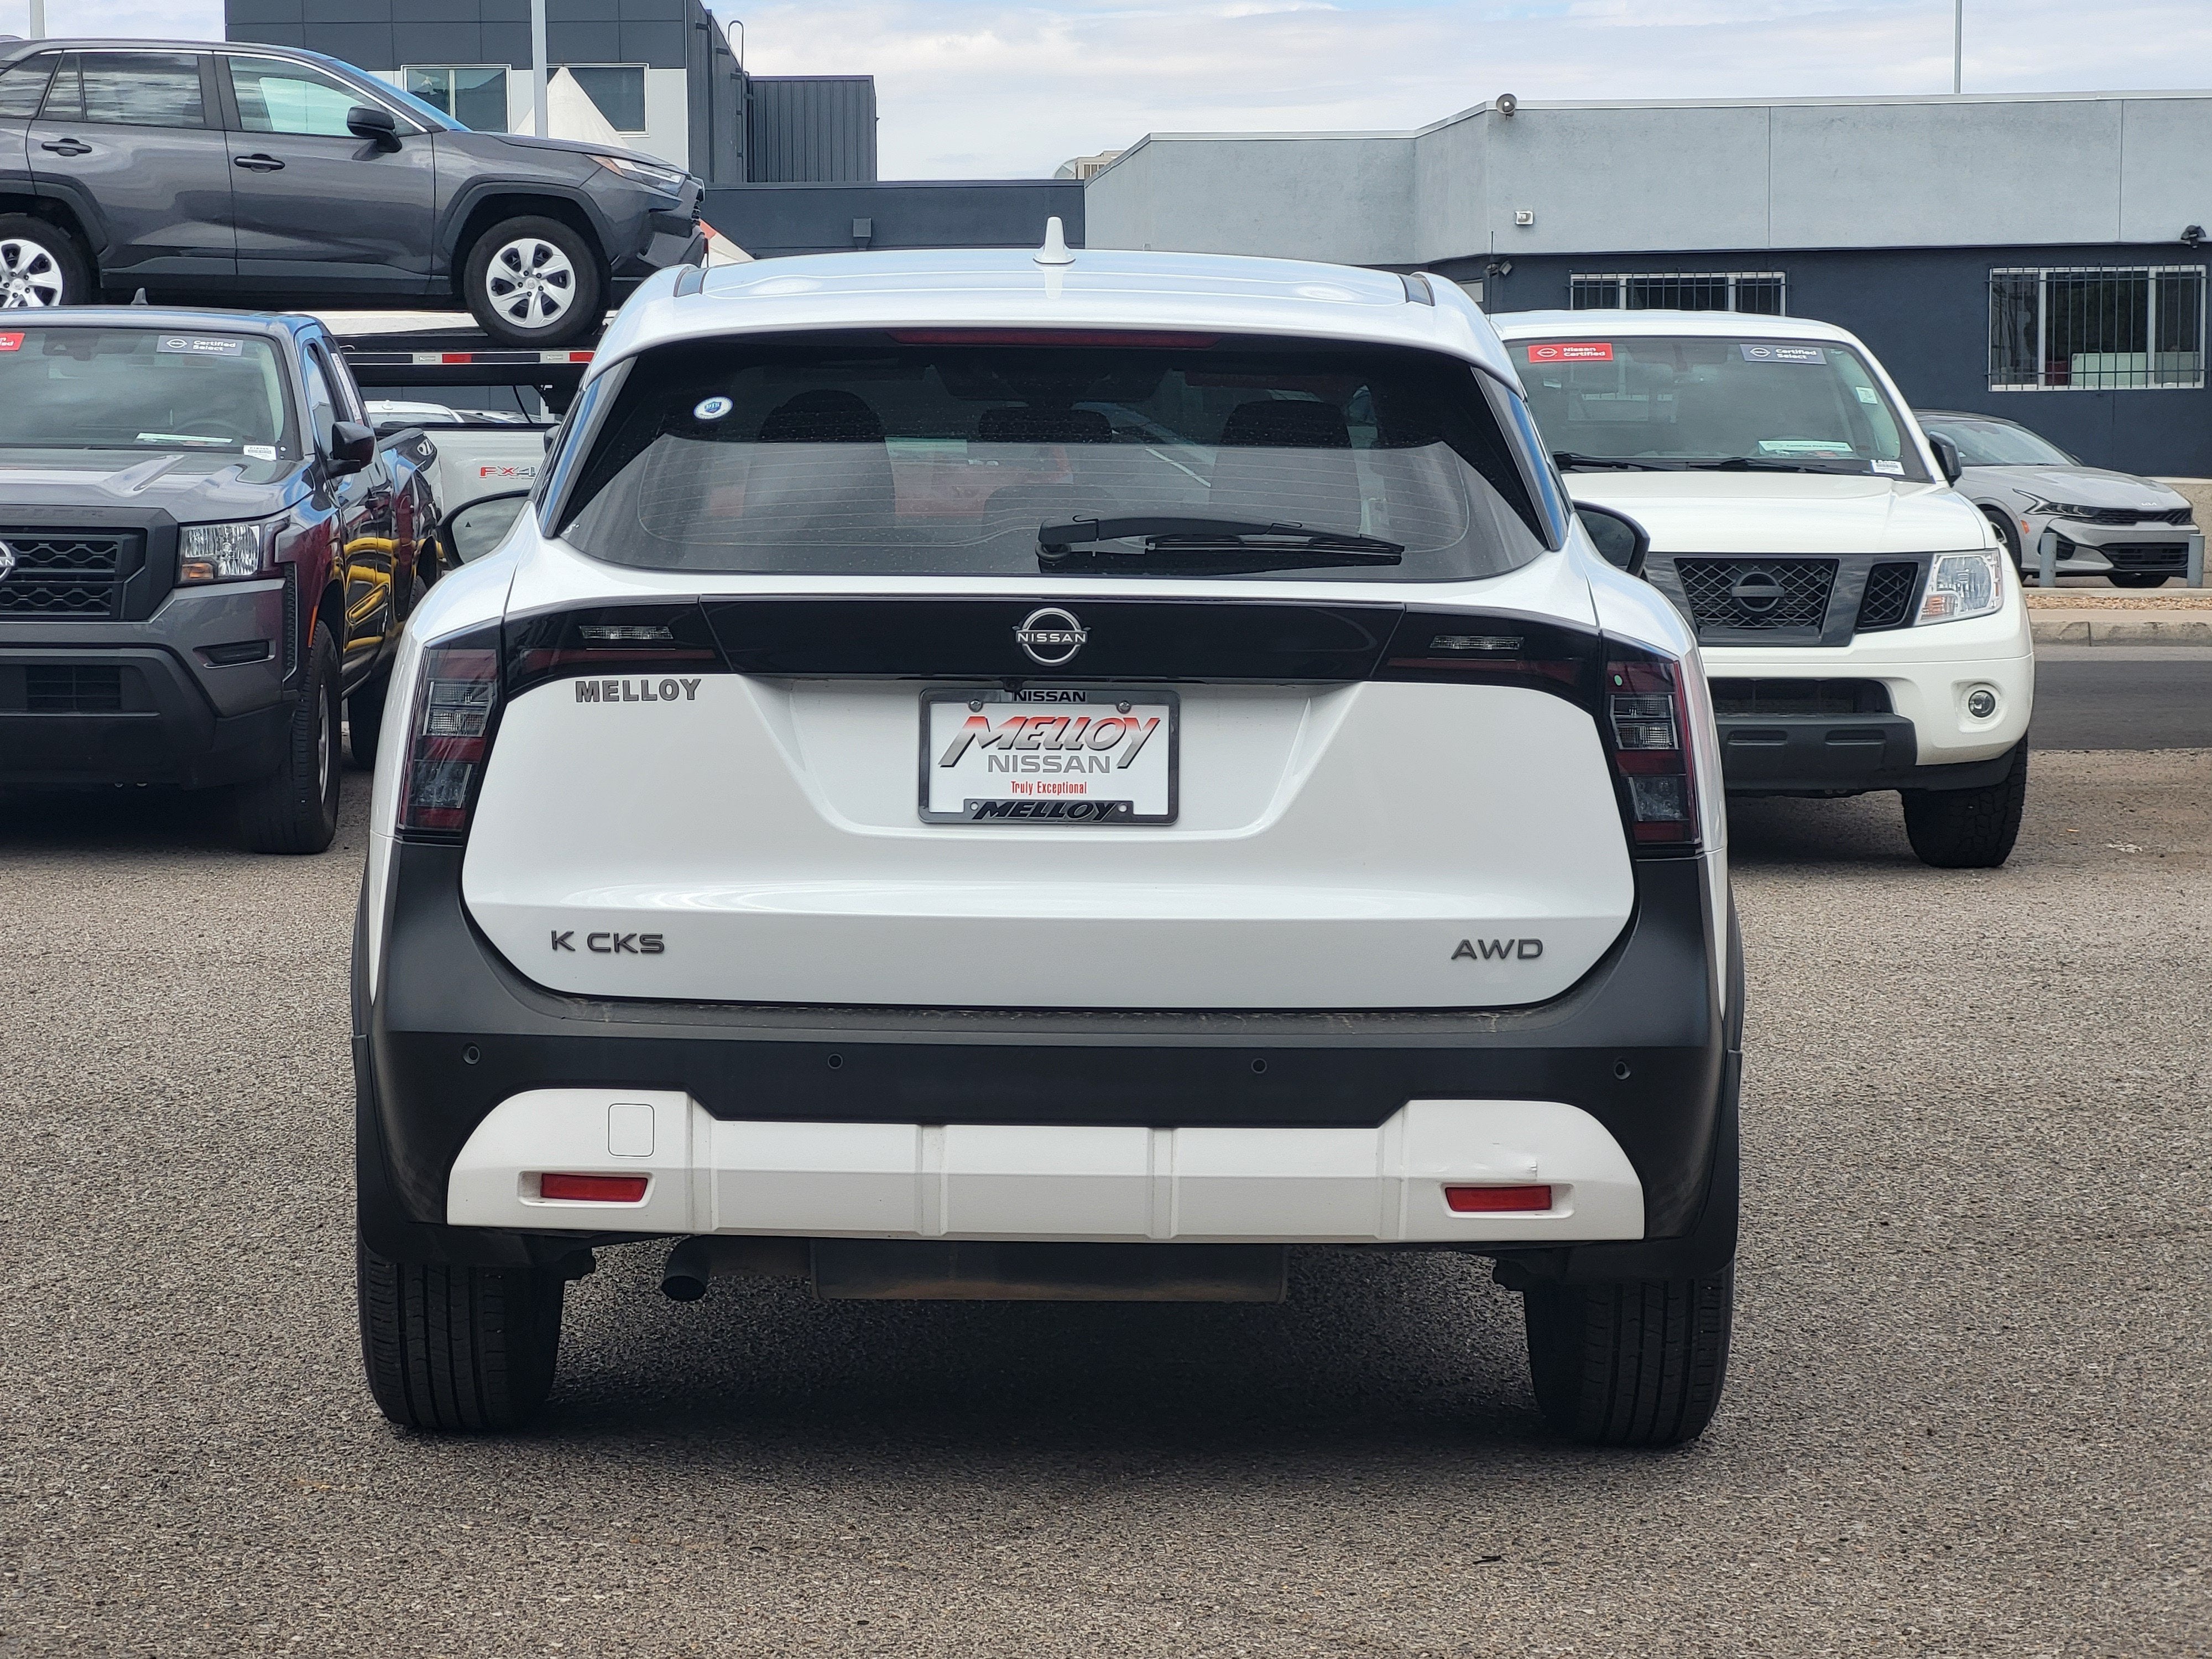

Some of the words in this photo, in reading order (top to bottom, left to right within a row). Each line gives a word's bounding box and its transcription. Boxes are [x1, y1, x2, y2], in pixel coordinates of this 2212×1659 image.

[479, 466, 536, 477] FX4
[1018, 633, 1086, 643] NISSAN
[575, 679, 702, 702] MELLOY
[1014, 691, 1086, 702] NISSAN
[938, 716, 1161, 769] MELLOY
[988, 754, 1110, 774] NISSAN
[1011, 781, 1033, 796] Truly
[1037, 781, 1087, 796] Exceptional
[972, 801, 1118, 822] MELLOY
[1451, 938, 1543, 960] AWD
